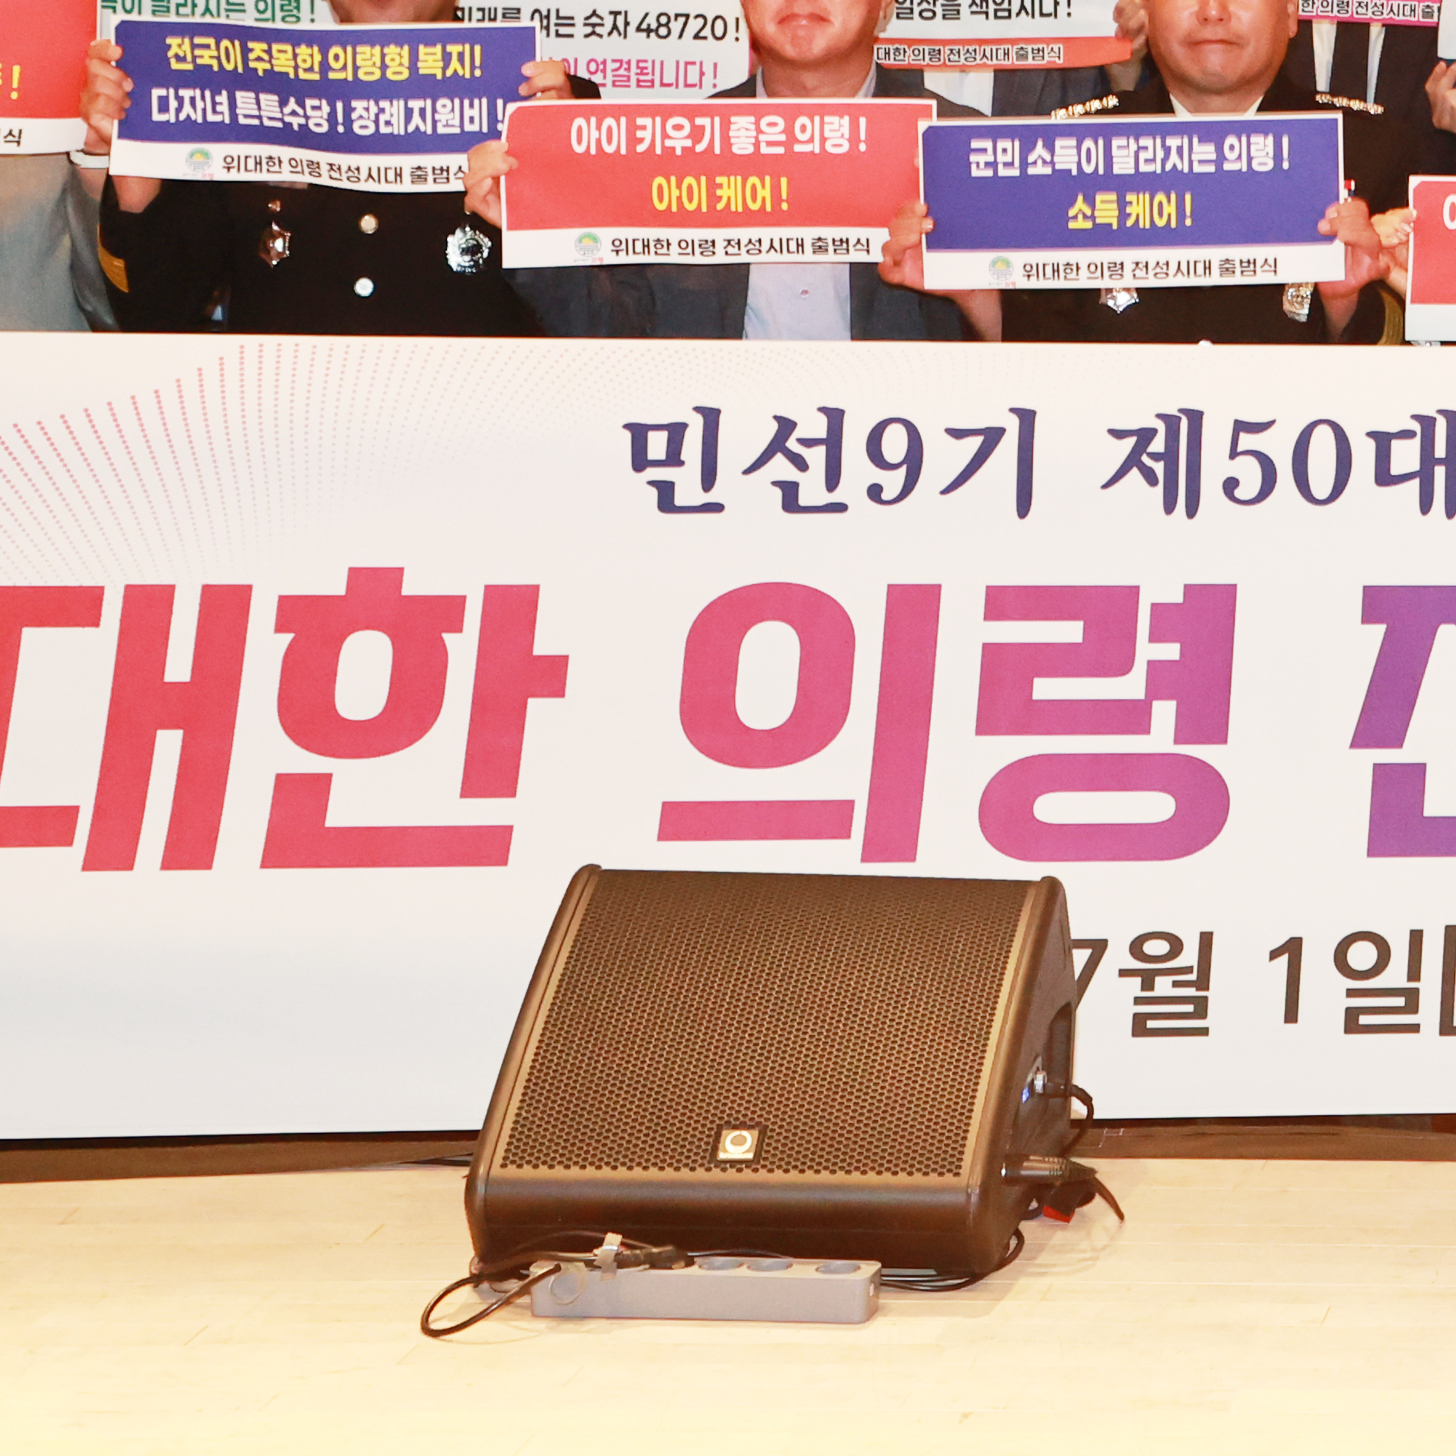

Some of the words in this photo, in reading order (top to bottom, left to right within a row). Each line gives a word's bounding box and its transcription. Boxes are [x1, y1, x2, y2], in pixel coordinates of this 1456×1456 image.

[584, 11, 630, 43] 숫자
[166, 37, 243, 71] 전국이
[248, 43, 322, 75] 주목한
[328, 48, 411, 78] 의령형
[151, 89, 231, 124] 다자녀
[571, 118, 627, 151] 아이
[636, 118, 721, 151] 키우기
[728, 116, 786, 153] 좋은
[970, 139, 1021, 176] 군민
[1028, 139, 1104, 175] 소득이
[1112, 137, 1217, 174] 달라지는
[652, 177, 707, 212] 아이
[1068, 193, 1119, 230] 소득
[624, 400, 1034, 518] 민선9기
[0, 564, 570, 872] 대한
[654, 577, 1236, 864] 의령
